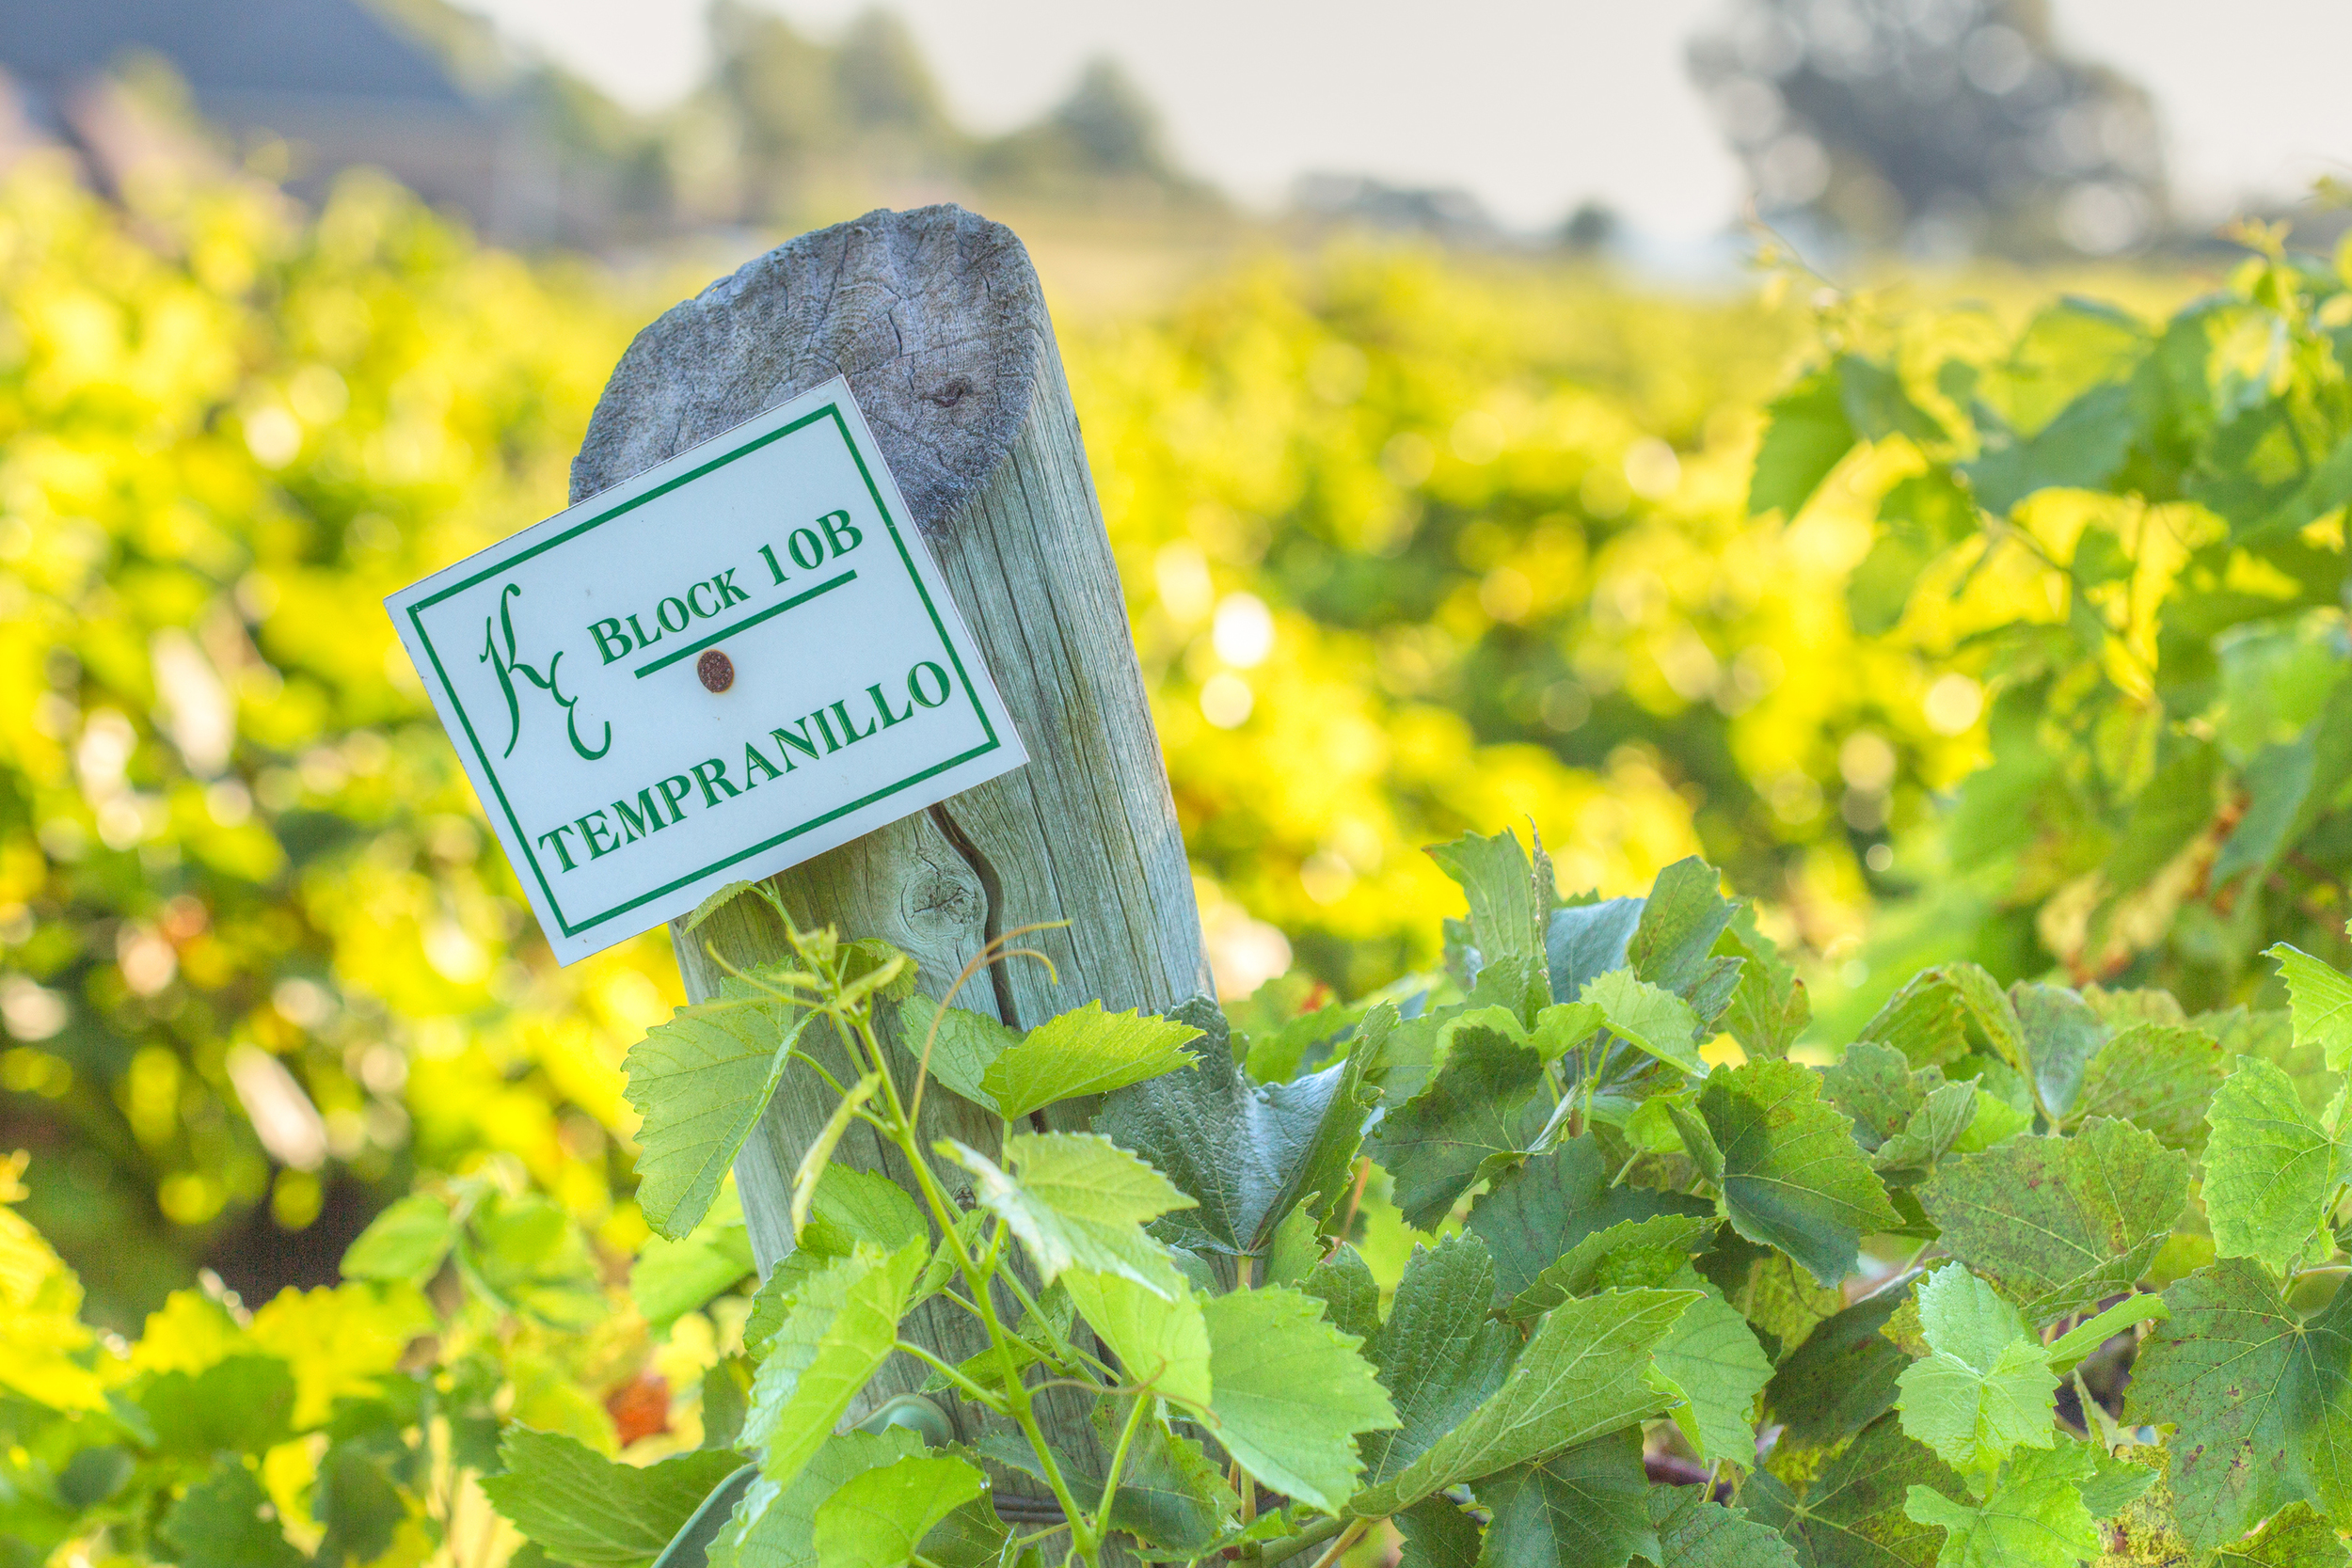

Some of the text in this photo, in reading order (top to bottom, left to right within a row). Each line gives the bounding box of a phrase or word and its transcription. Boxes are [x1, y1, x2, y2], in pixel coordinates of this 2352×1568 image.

[586, 509, 864, 666] BLOCK 10B
[537, 660, 951, 874] TEMPRANILLO
